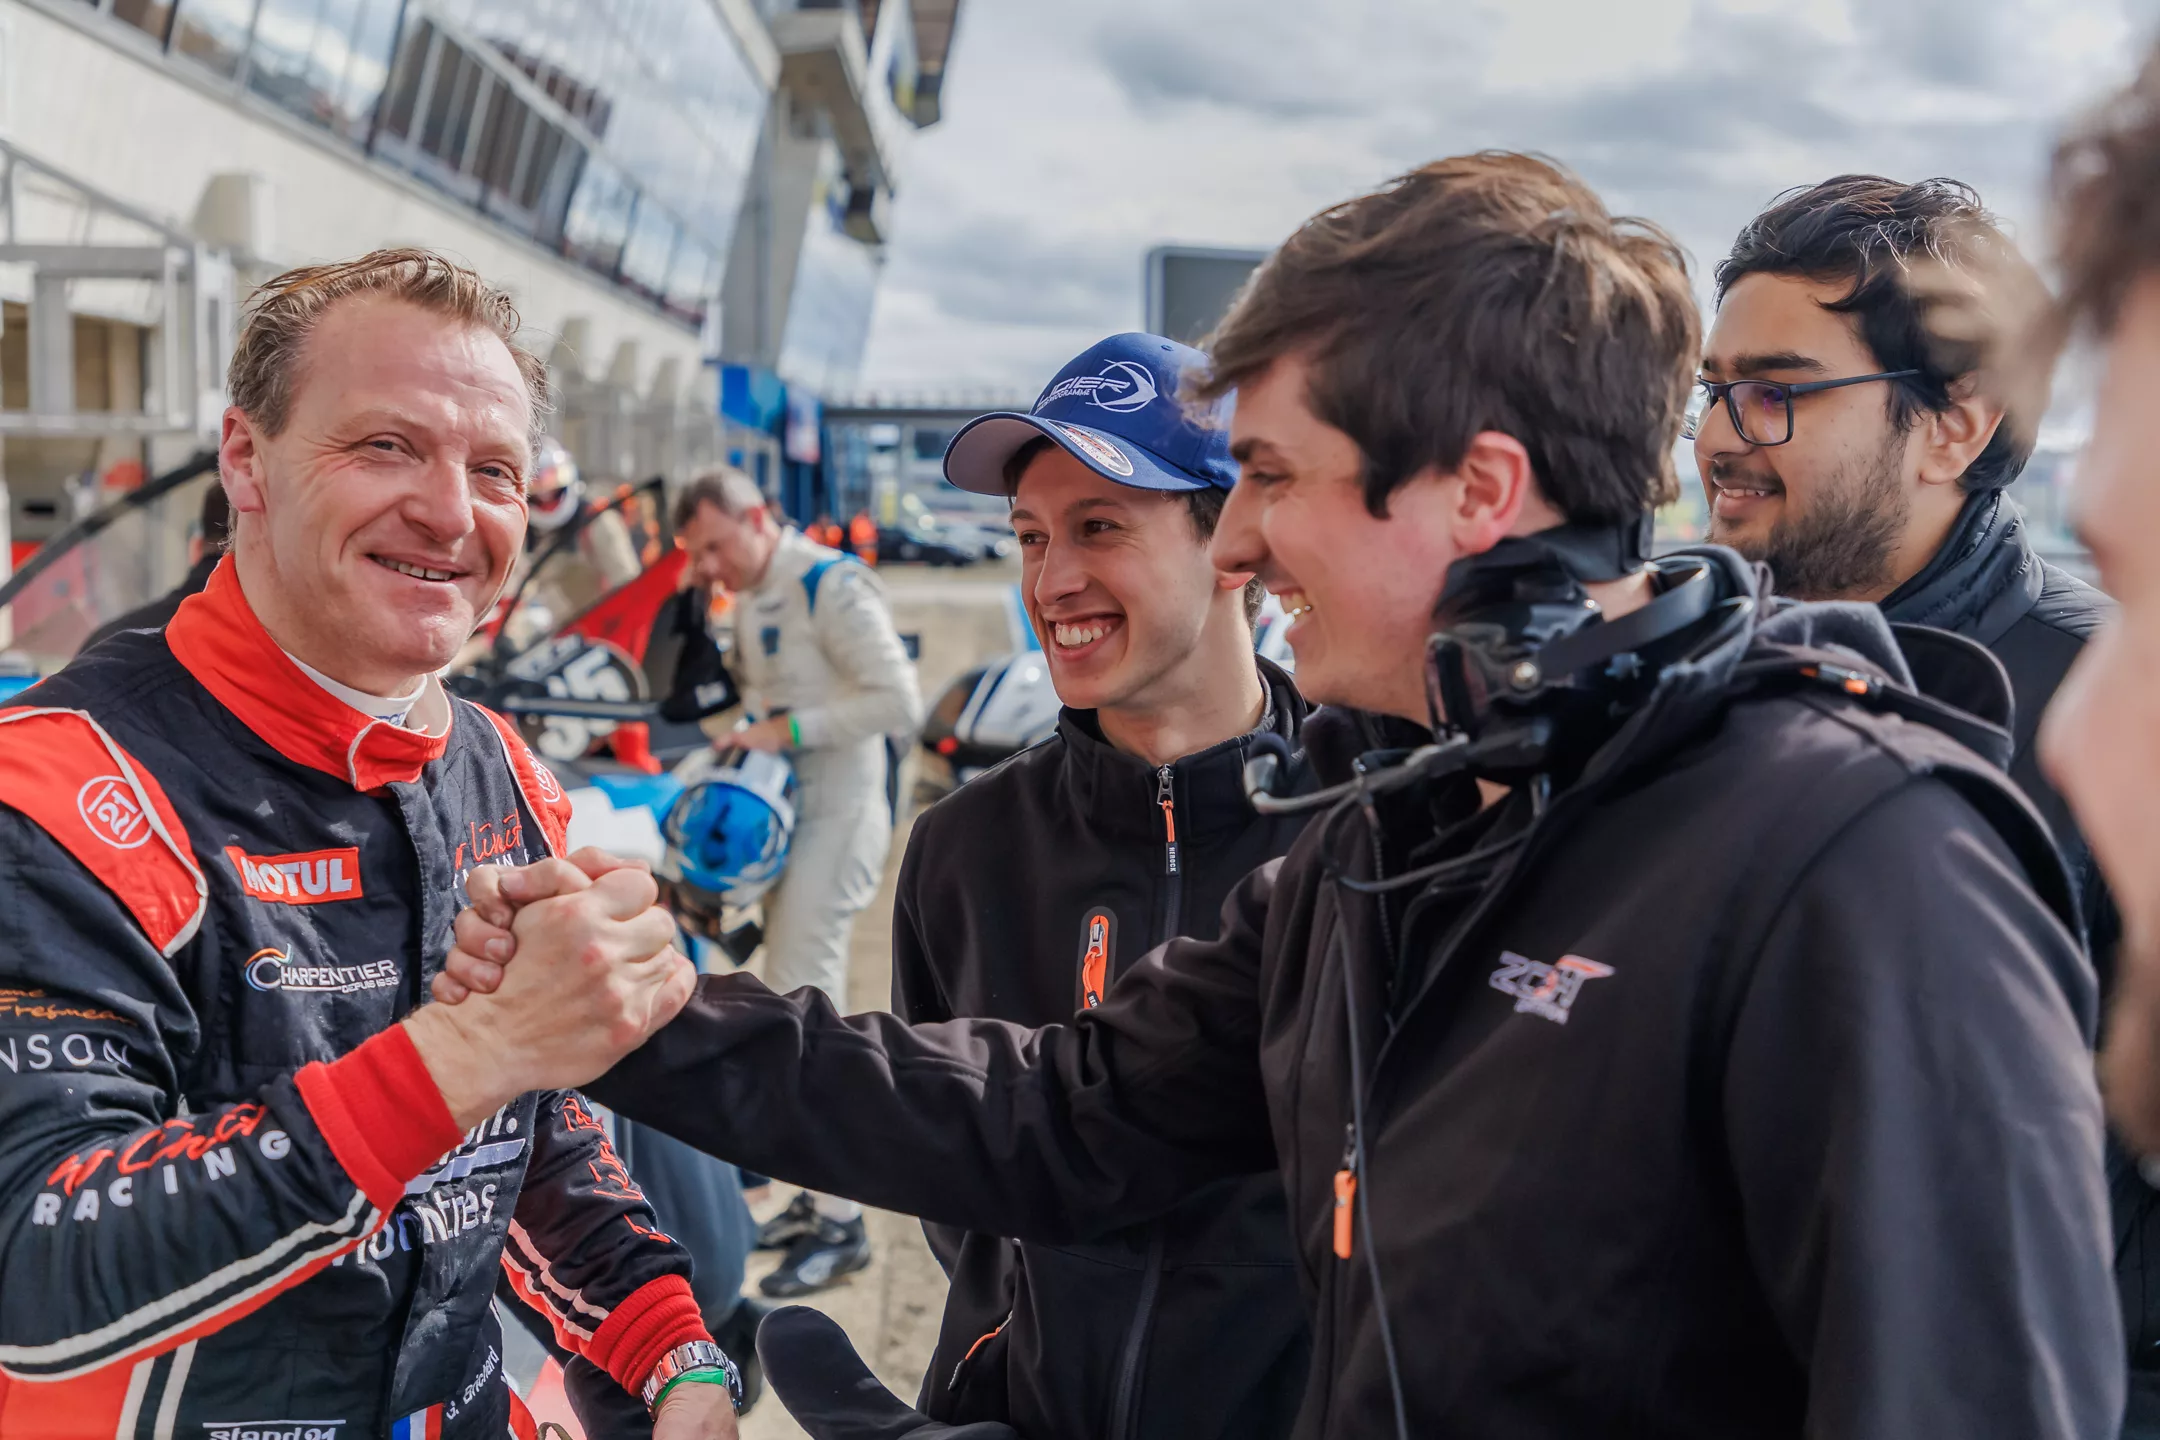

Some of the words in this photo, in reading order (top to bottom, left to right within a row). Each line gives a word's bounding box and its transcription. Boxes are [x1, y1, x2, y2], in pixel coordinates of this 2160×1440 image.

[241, 857, 353, 897] MOTUL
[1168, 847, 1177, 873] HEROCK
[252, 957, 396, 989] CHARPENTIER
[31, 1130, 291, 1226] RACING
